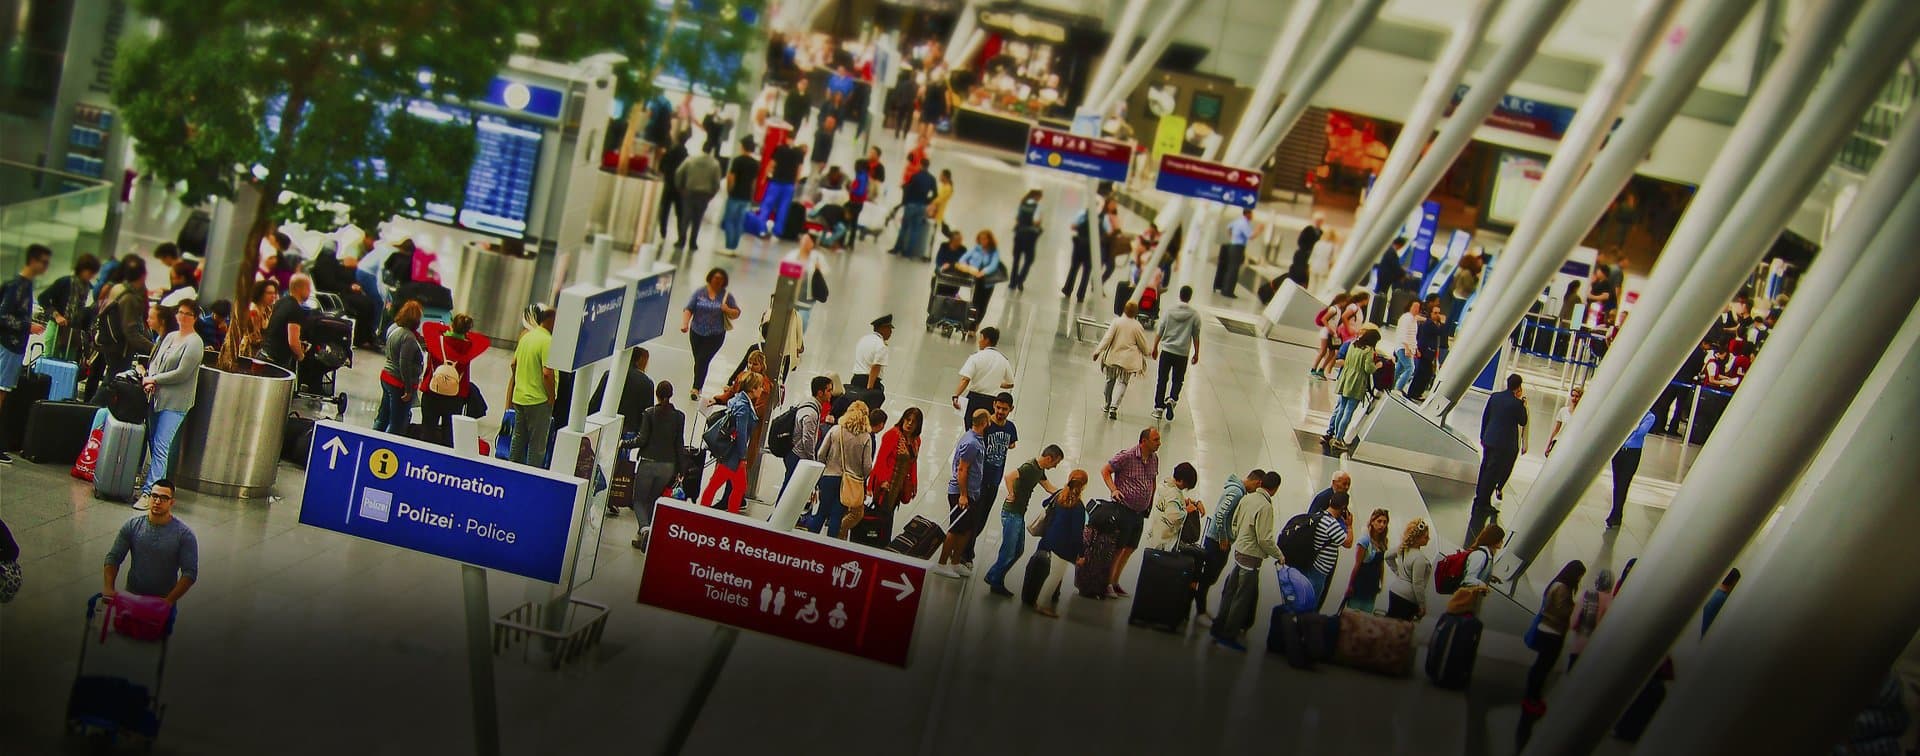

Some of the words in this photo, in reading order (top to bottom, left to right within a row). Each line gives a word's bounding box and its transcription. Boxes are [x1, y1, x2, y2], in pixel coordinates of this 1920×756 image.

[404, 461, 505, 499] Information
[397, 502, 455, 529] Polizei
[465, 518, 516, 544] Police
[668, 523, 716, 548] Shops
[719, 537, 731, 552] &
[734, 540, 825, 575] Restaurants
[689, 562, 753, 590] Toiletten
[704, 584, 750, 607] Toilets
